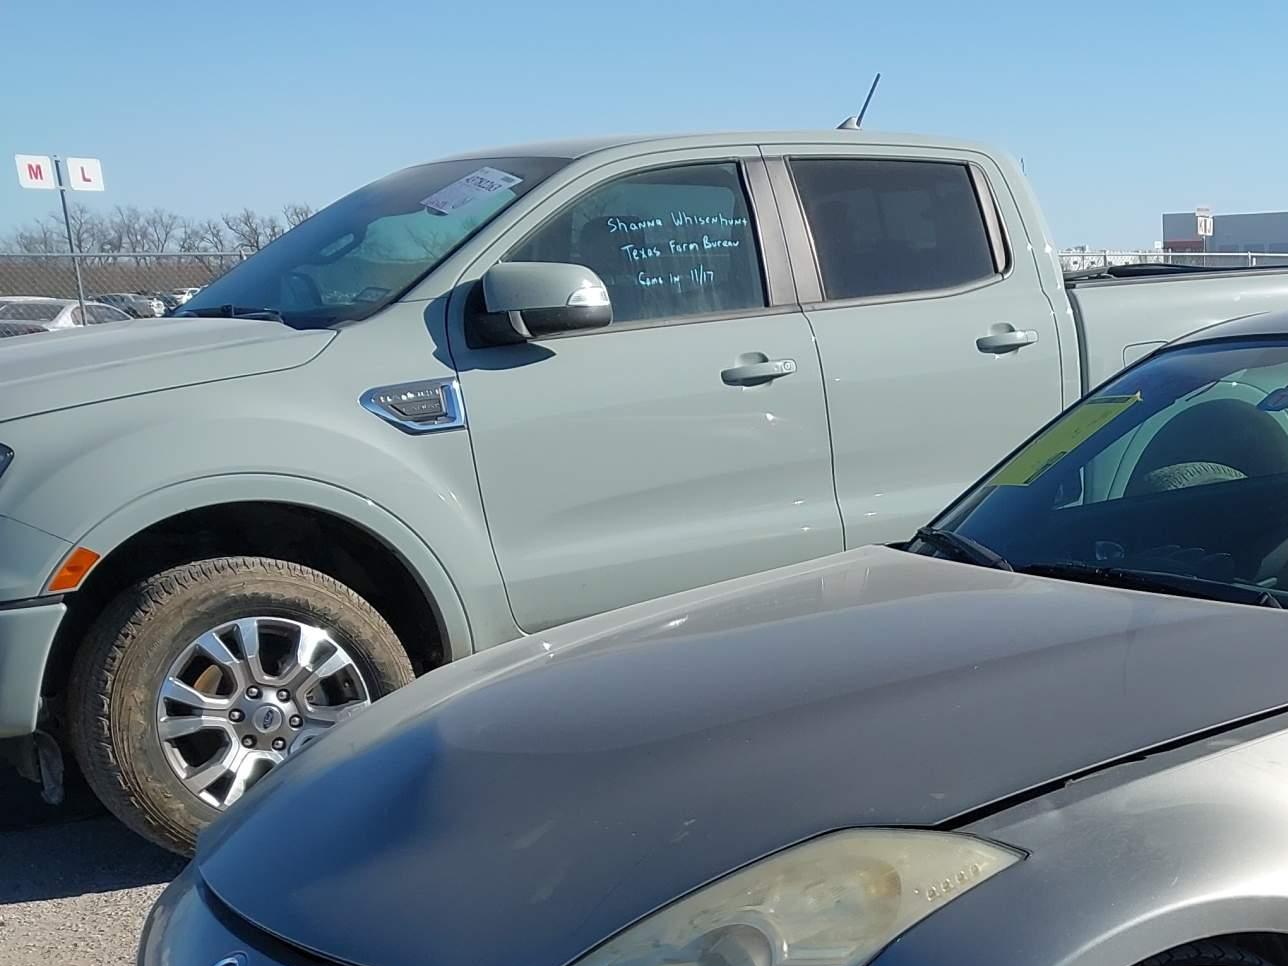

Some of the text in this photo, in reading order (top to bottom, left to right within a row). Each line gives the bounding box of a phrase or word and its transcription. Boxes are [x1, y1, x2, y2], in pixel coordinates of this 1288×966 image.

[27, 163, 44, 181] M
[80, 166, 92, 182] L
[620, 235, 740, 262] Texas Farm Bureau
[690, 264, 714, 286] 11/17
